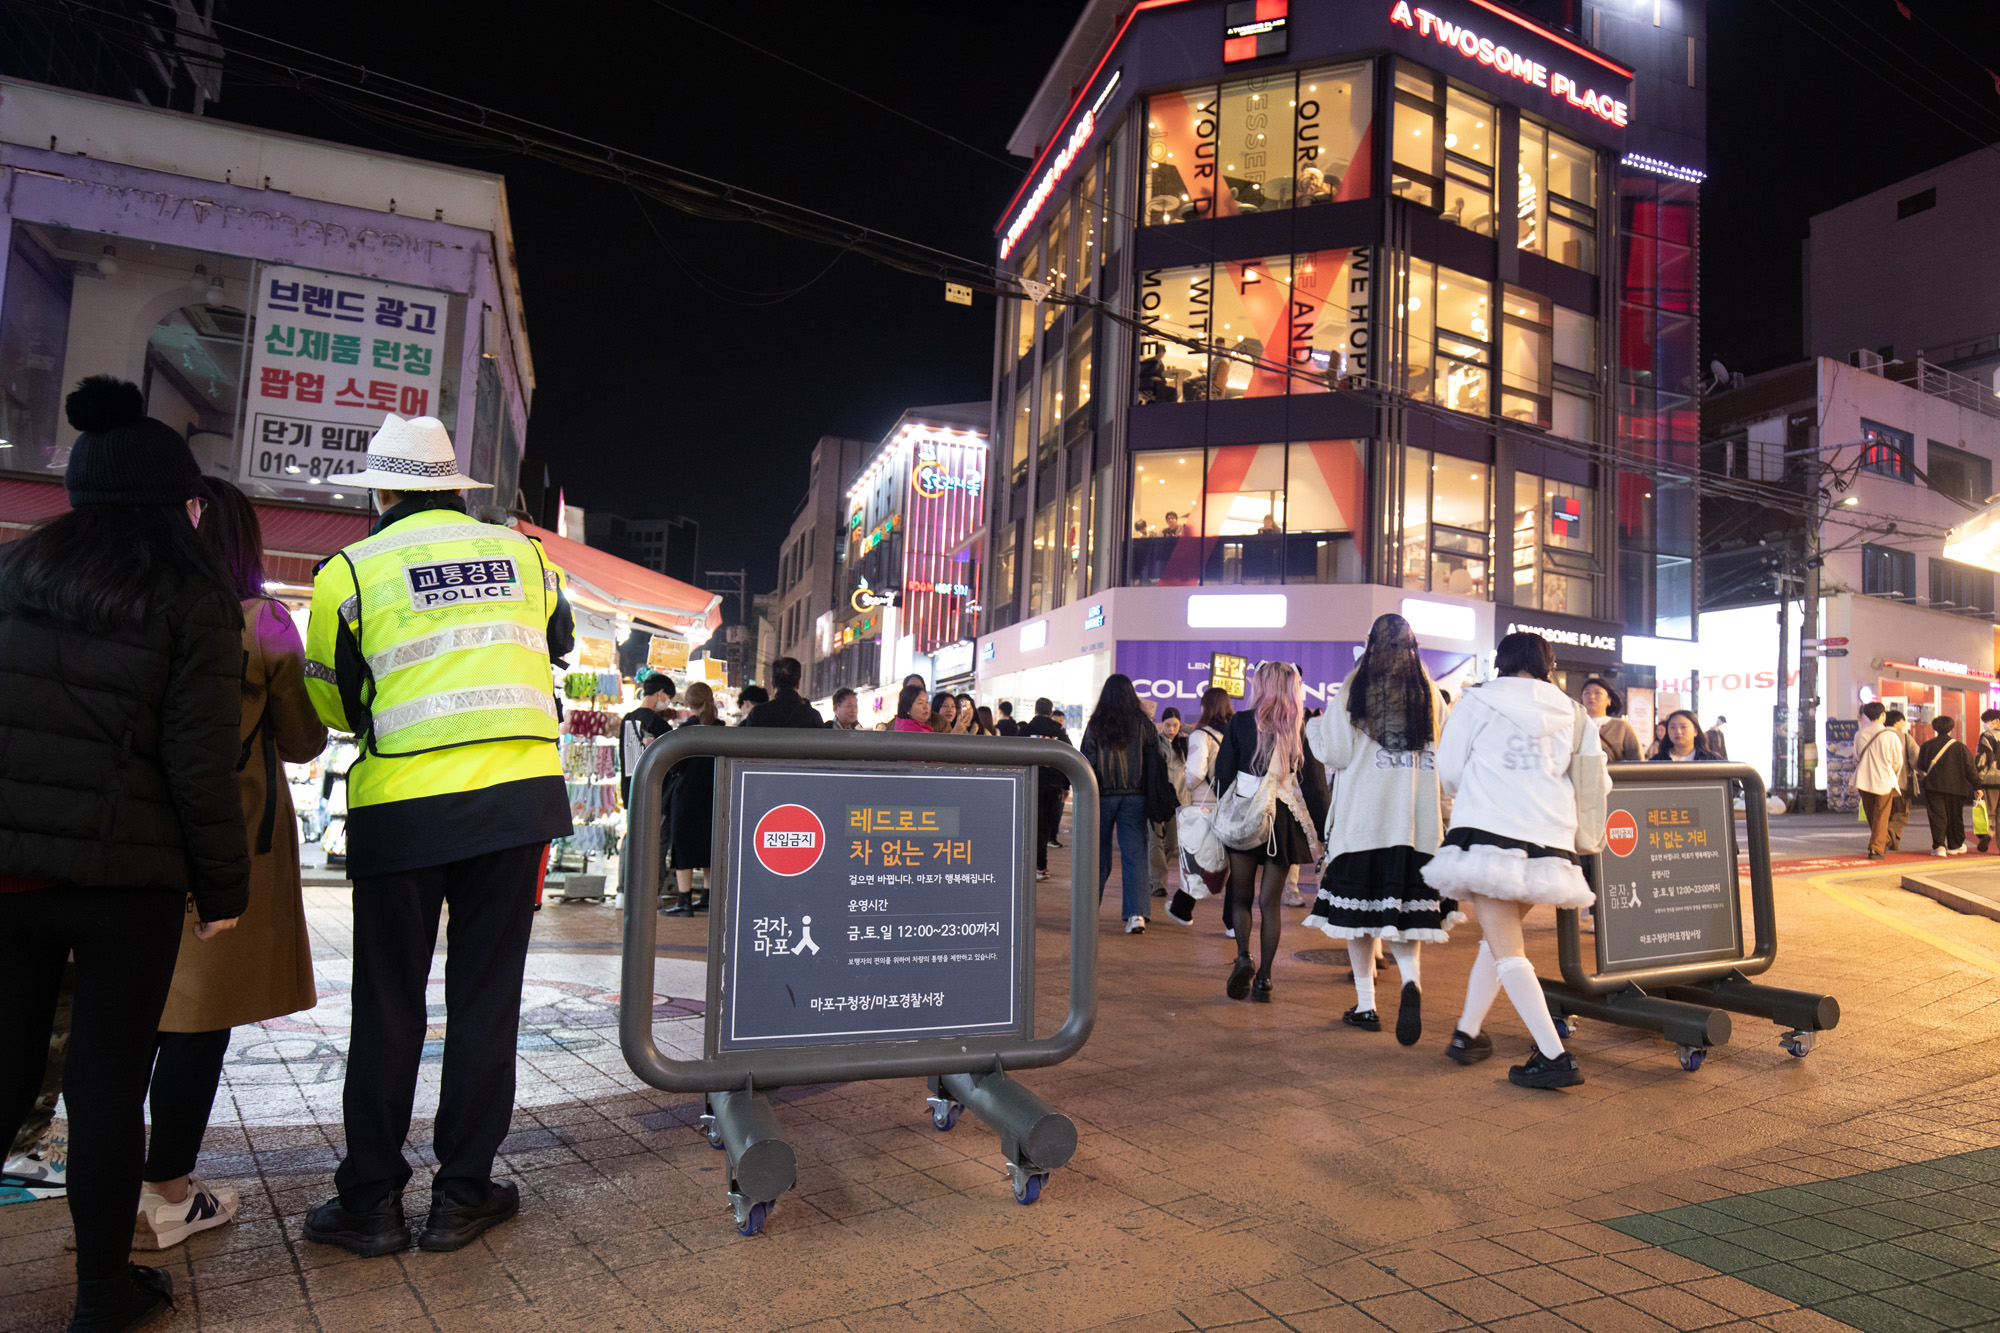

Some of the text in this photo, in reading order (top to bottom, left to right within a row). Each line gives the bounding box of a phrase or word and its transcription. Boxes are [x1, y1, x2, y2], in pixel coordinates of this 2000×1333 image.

[1391, 1, 1628, 126] A TWOSOME PLACE
[1194, 100, 1216, 180] YOUR
[1297, 100, 1320, 163] OUR
[1351, 247, 1370, 294] WE
[268, 279, 436, 335] 브랜드 광고
[1293, 301, 1315, 364] AND
[265, 324, 433, 376] 신제품 런칭
[260, 367, 429, 416] 팝업 스토어
[262, 420, 378, 453] 단기 임대
[259, 451, 367, 478] 010-8741-
[416, 562, 511, 588] 교통경찰
[425, 586, 512, 605] POLICE
[1580, 633, 1616, 651] PLACE
[1187, 662, 1211, 670] LEN
[1215, 655, 1246, 680] 반값
[850, 808, 940, 833] 레드로드
[1648, 809, 1691, 827] 레드로드
[766, 833, 813, 847] 진입금지
[1649, 829, 1707, 849] 차 없는 거리
[850, 839, 972, 867] 차 없는 거리
[848, 873, 997, 886] 걸으면 바뀝니다. 마포가 행복해집니다.
[847, 899, 889, 912] 운영시간
[753, 917, 793, 939] 걷자,
[846, 921, 1000, 941] 금.토.일 12:00~23:00까지
[754, 937, 791, 957] 마포
[847, 957, 873, 966] 보행자의
[974, 952, 998, 961] 있습니다.
[810, 992, 945, 1012] 마포구청장/마포경찰서장
